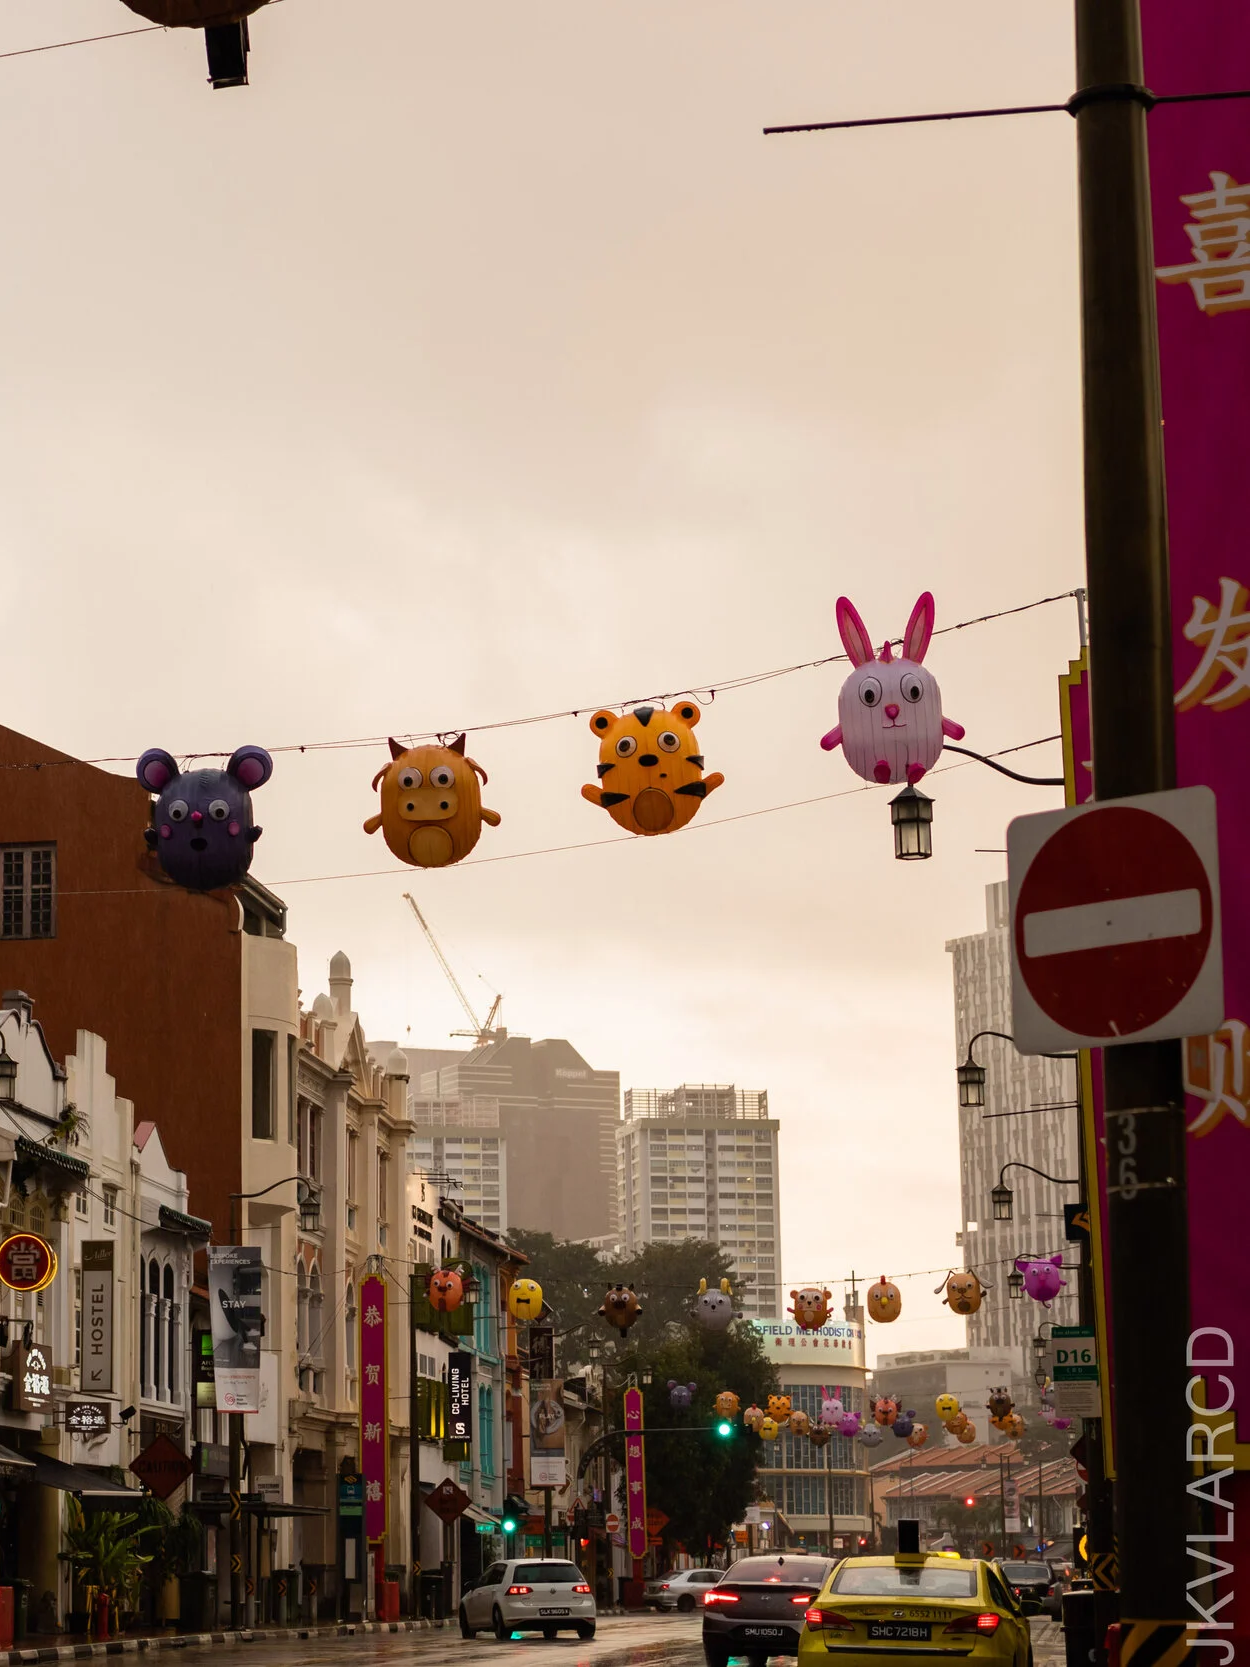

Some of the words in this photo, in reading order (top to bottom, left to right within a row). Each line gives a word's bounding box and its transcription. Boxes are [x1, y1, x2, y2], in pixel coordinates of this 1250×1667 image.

[221, 1300, 247, 1309] STAY
[91, 1284, 104, 1355] HOSTEL
[1056, 1349, 1091, 1364] D16
[451, 1367, 460, 1415] CO-LIVING
[461, 1377, 470, 1406] HOTEL
[909, 1610, 930, 1618] 6552
